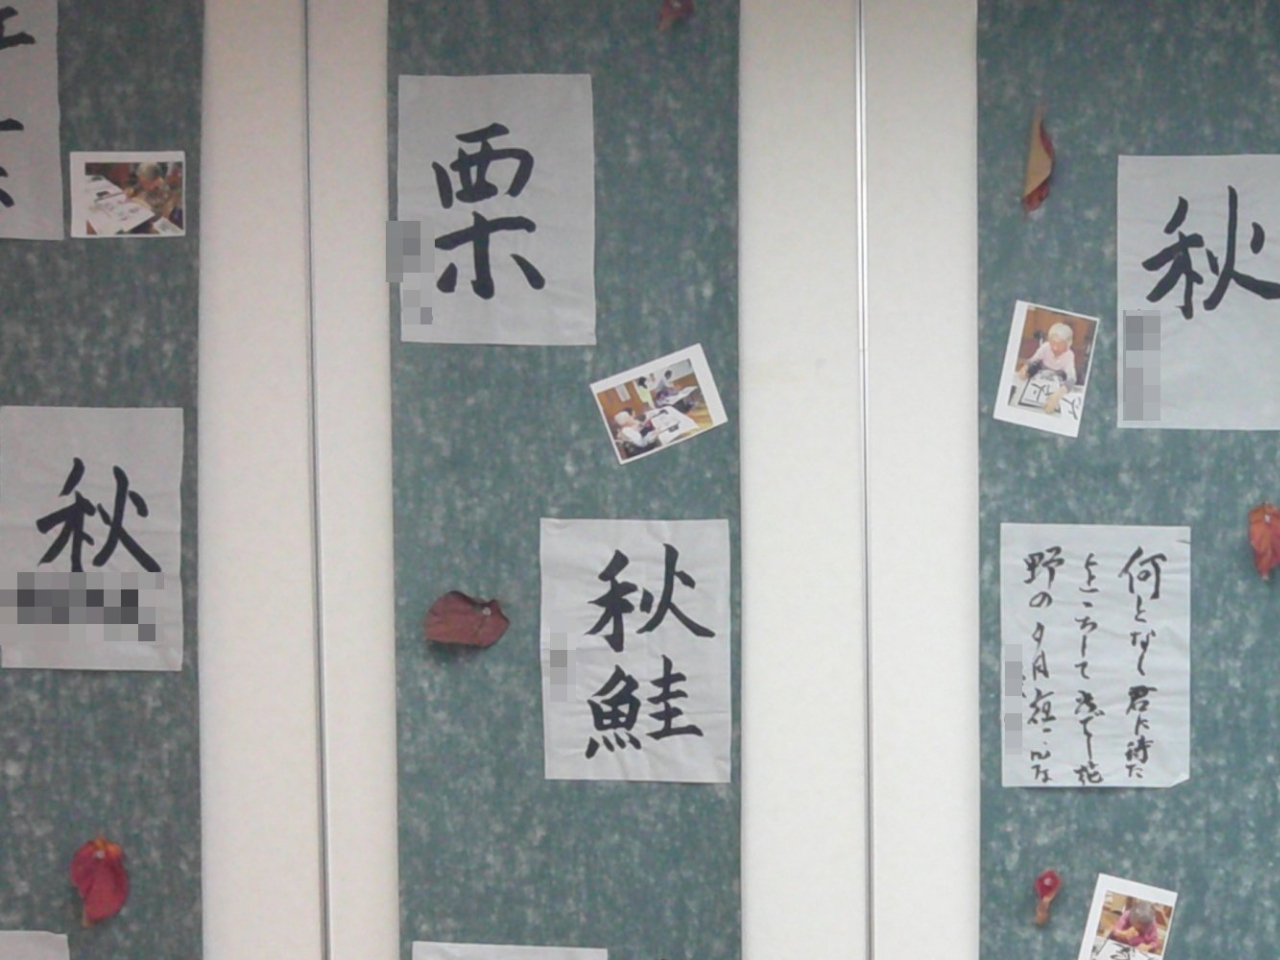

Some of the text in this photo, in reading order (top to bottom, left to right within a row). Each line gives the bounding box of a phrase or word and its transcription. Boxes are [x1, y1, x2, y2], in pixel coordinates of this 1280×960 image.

[433, 122, 546, 300] 栗
[36, 457, 162, 573] 秋
[585, 544, 716, 759] 秋鮭
